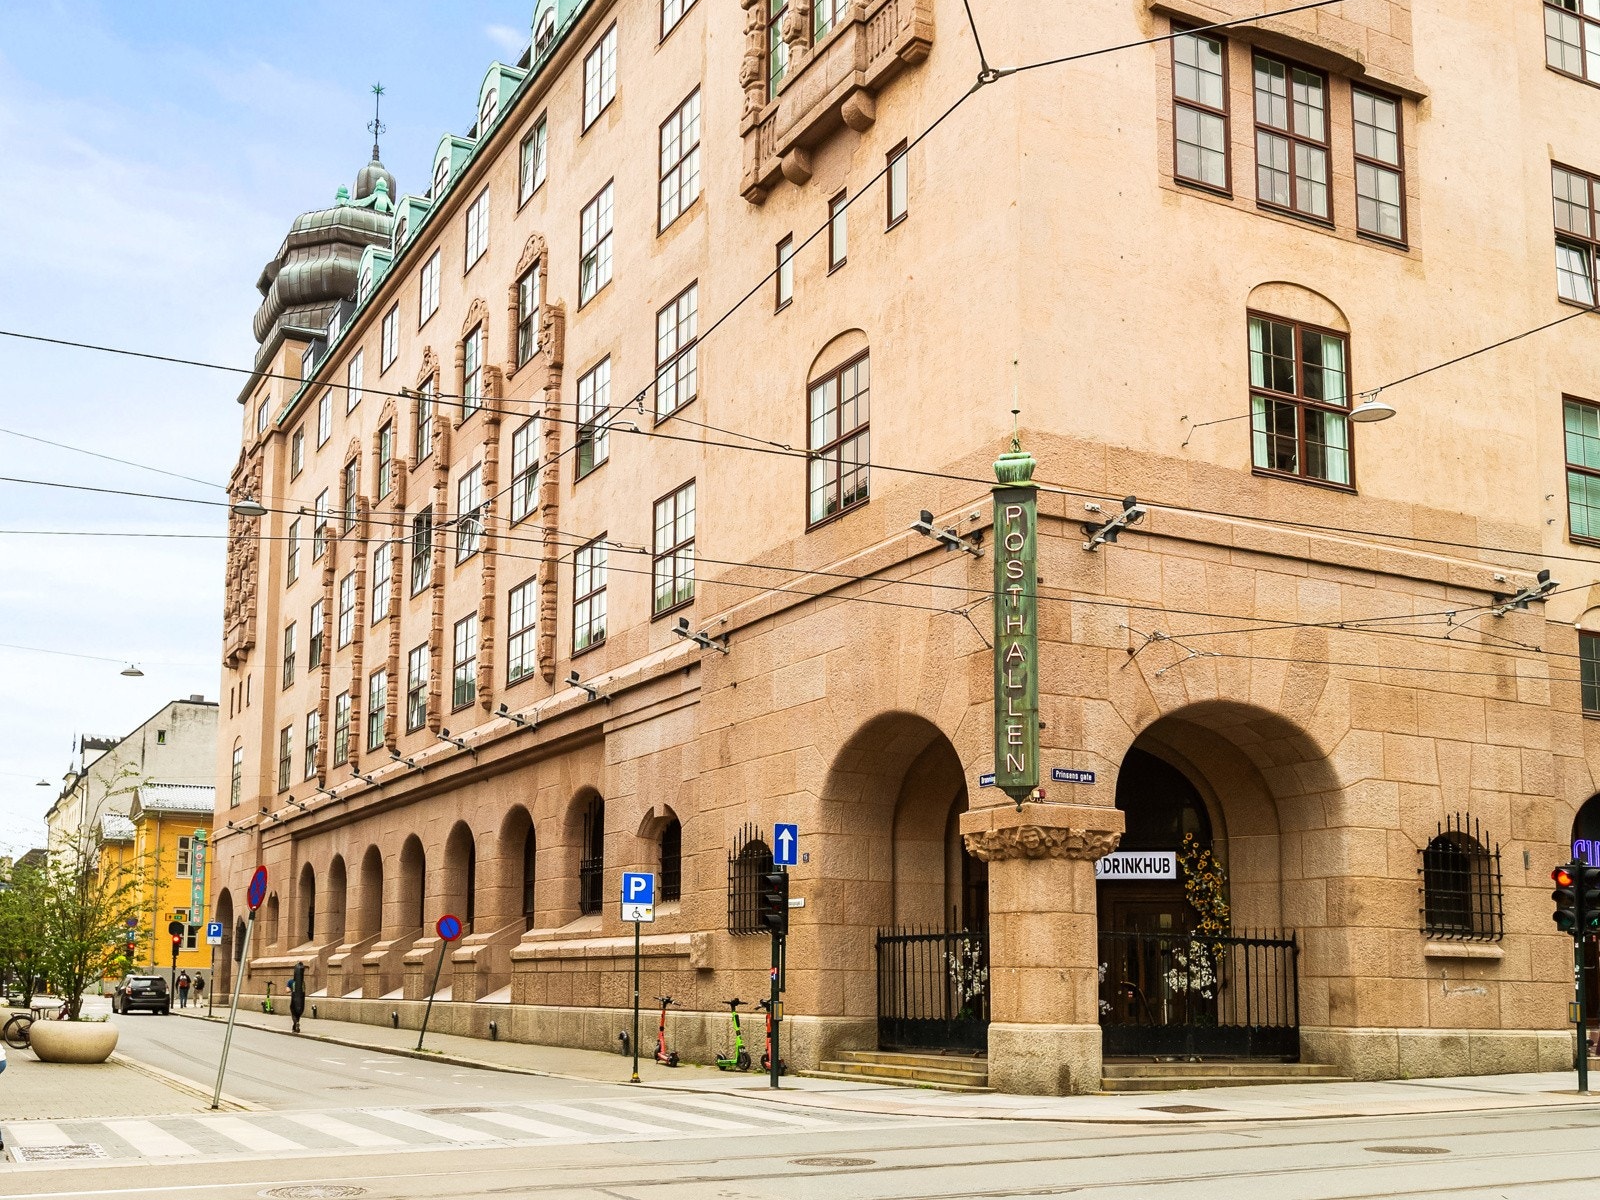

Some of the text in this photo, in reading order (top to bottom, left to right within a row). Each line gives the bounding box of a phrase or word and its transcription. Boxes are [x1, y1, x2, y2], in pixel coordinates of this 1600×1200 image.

[1004, 506, 1025, 772] POSTHALLEN
[1055, 770, 1093, 782] Prinsens gate
[1103, 857, 1171, 874] DRINKHUB
[194, 844, 203, 923] POSTHALLEN
[630, 877, 647, 900] P
[211, 925, 219, 935] P
